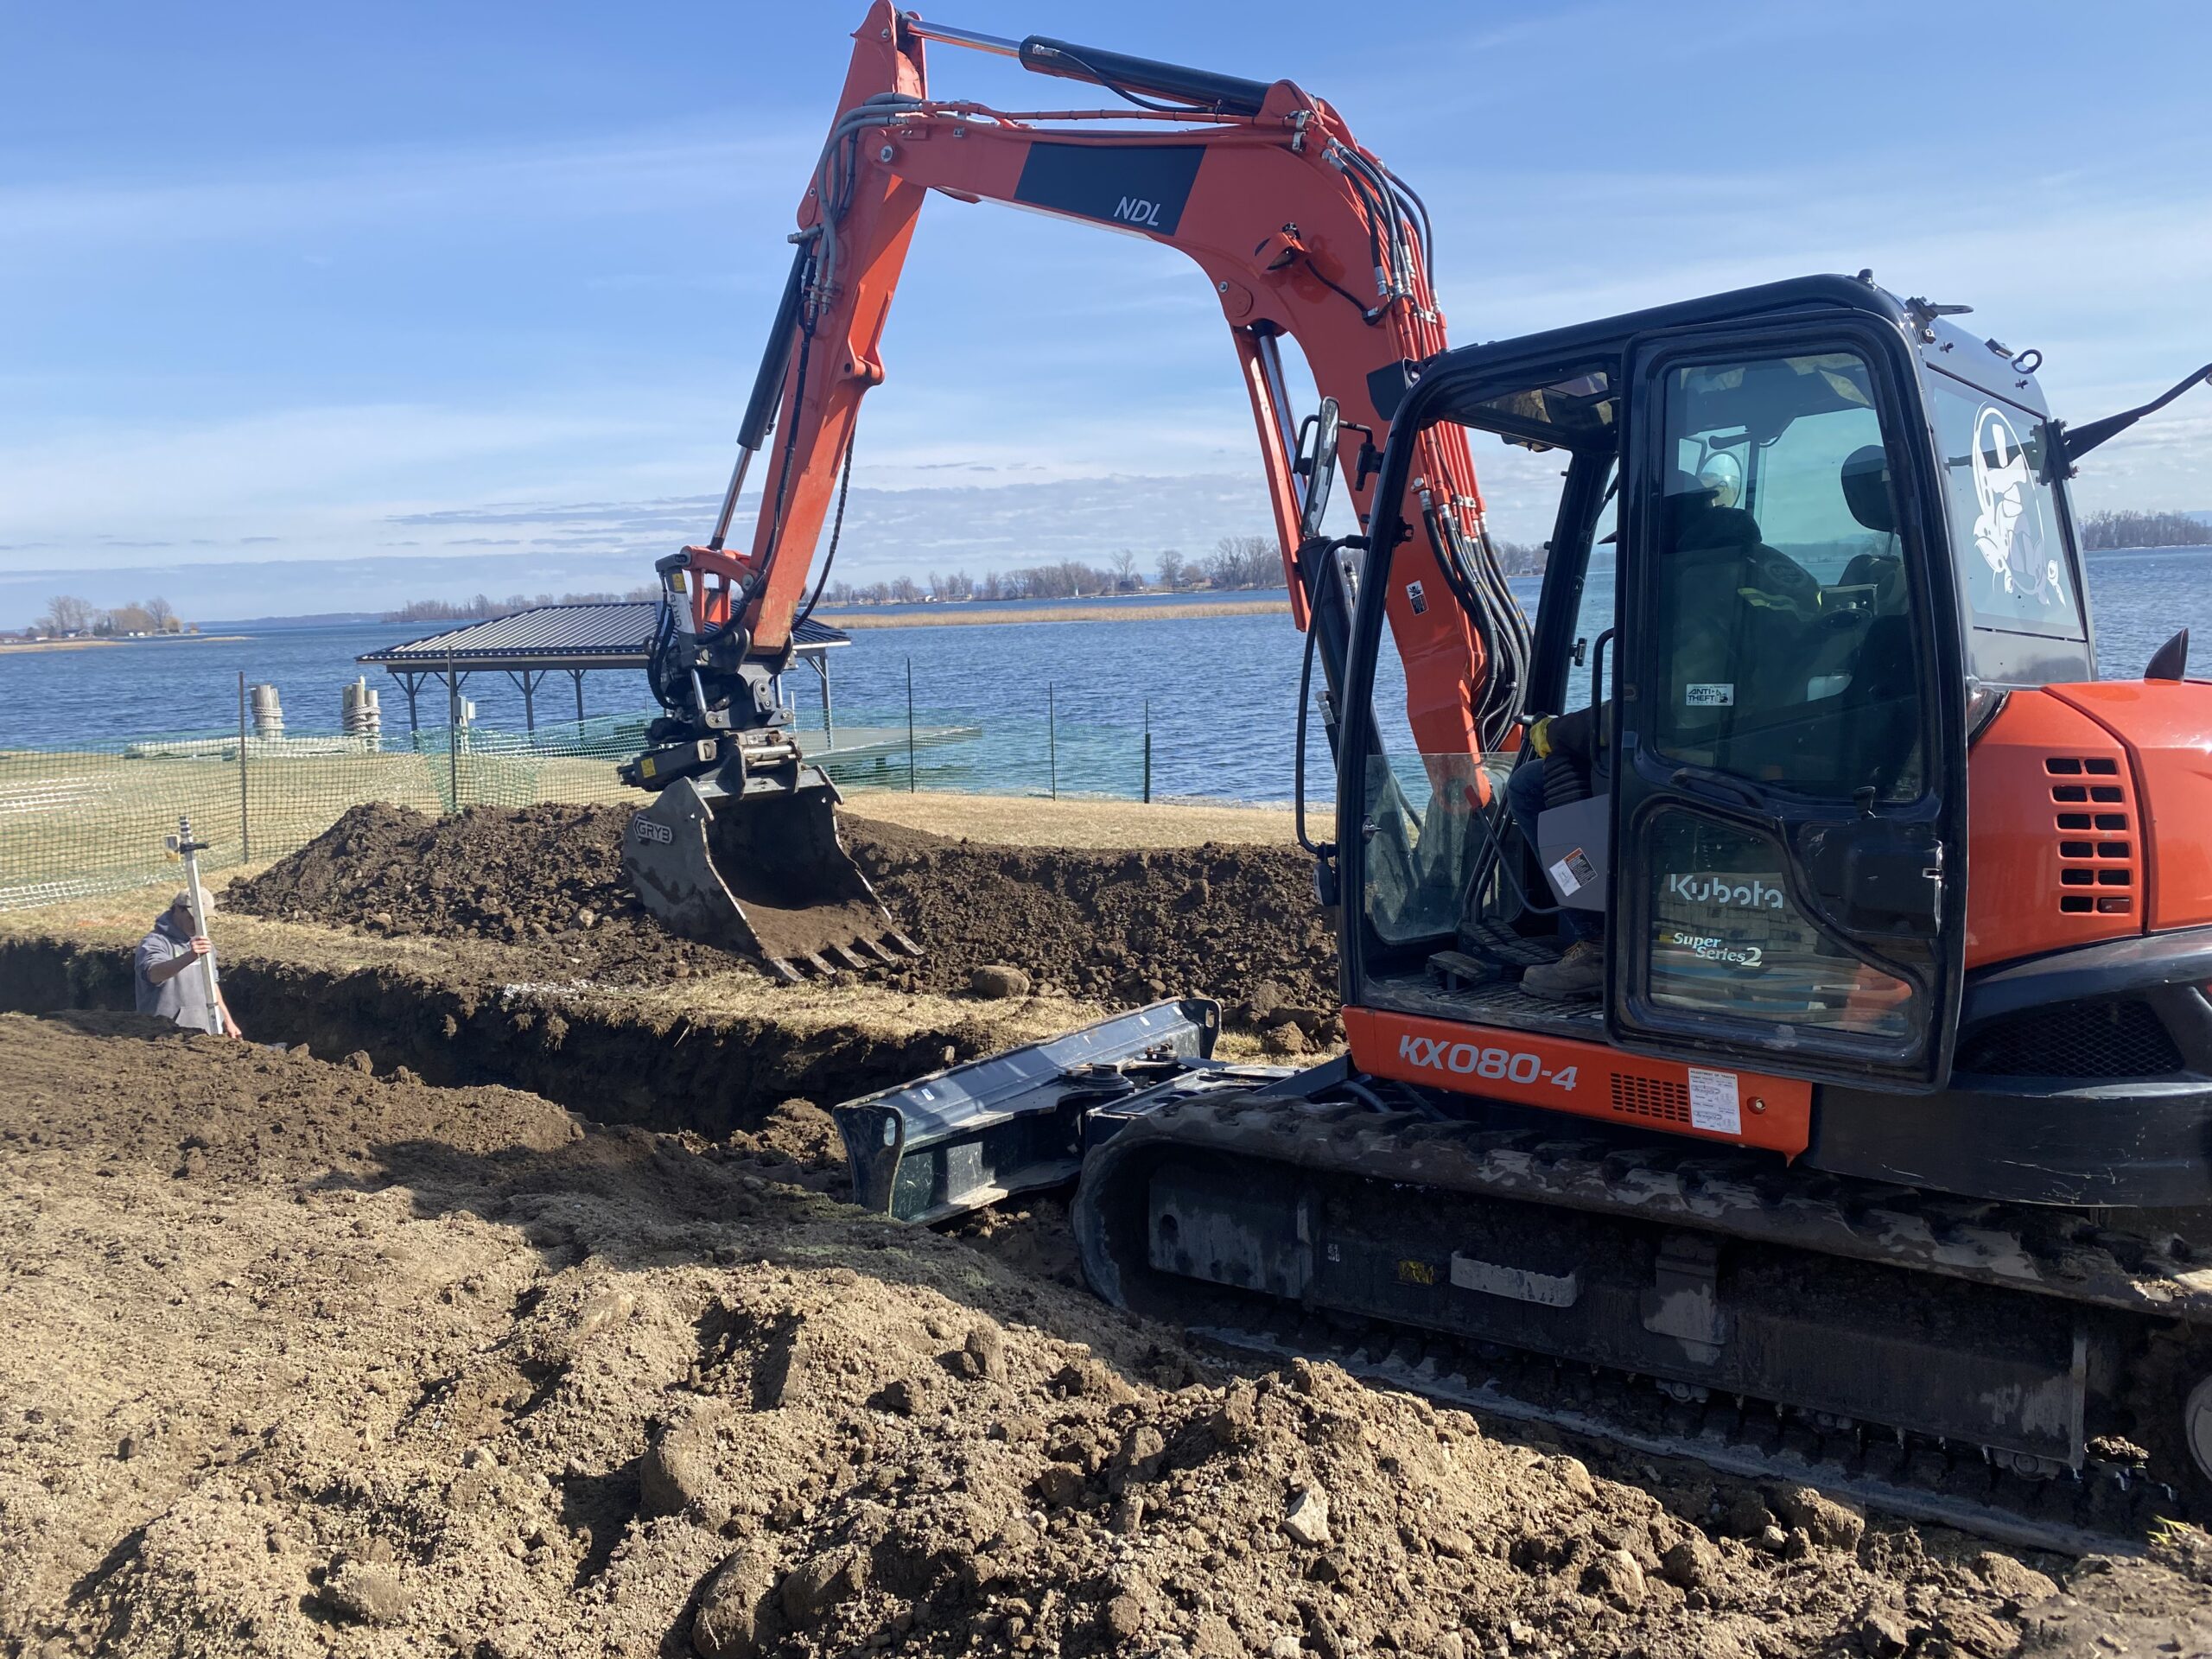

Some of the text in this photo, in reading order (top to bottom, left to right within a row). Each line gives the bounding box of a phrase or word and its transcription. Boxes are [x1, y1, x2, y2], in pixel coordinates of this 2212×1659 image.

[1113, 195, 1161, 226] NDL
[637, 821, 671, 842] GRYB
[1669, 873, 1784, 909] Kubota
[1672, 932, 1722, 950] Super
[1398, 1034, 1579, 1092] KX080-4
